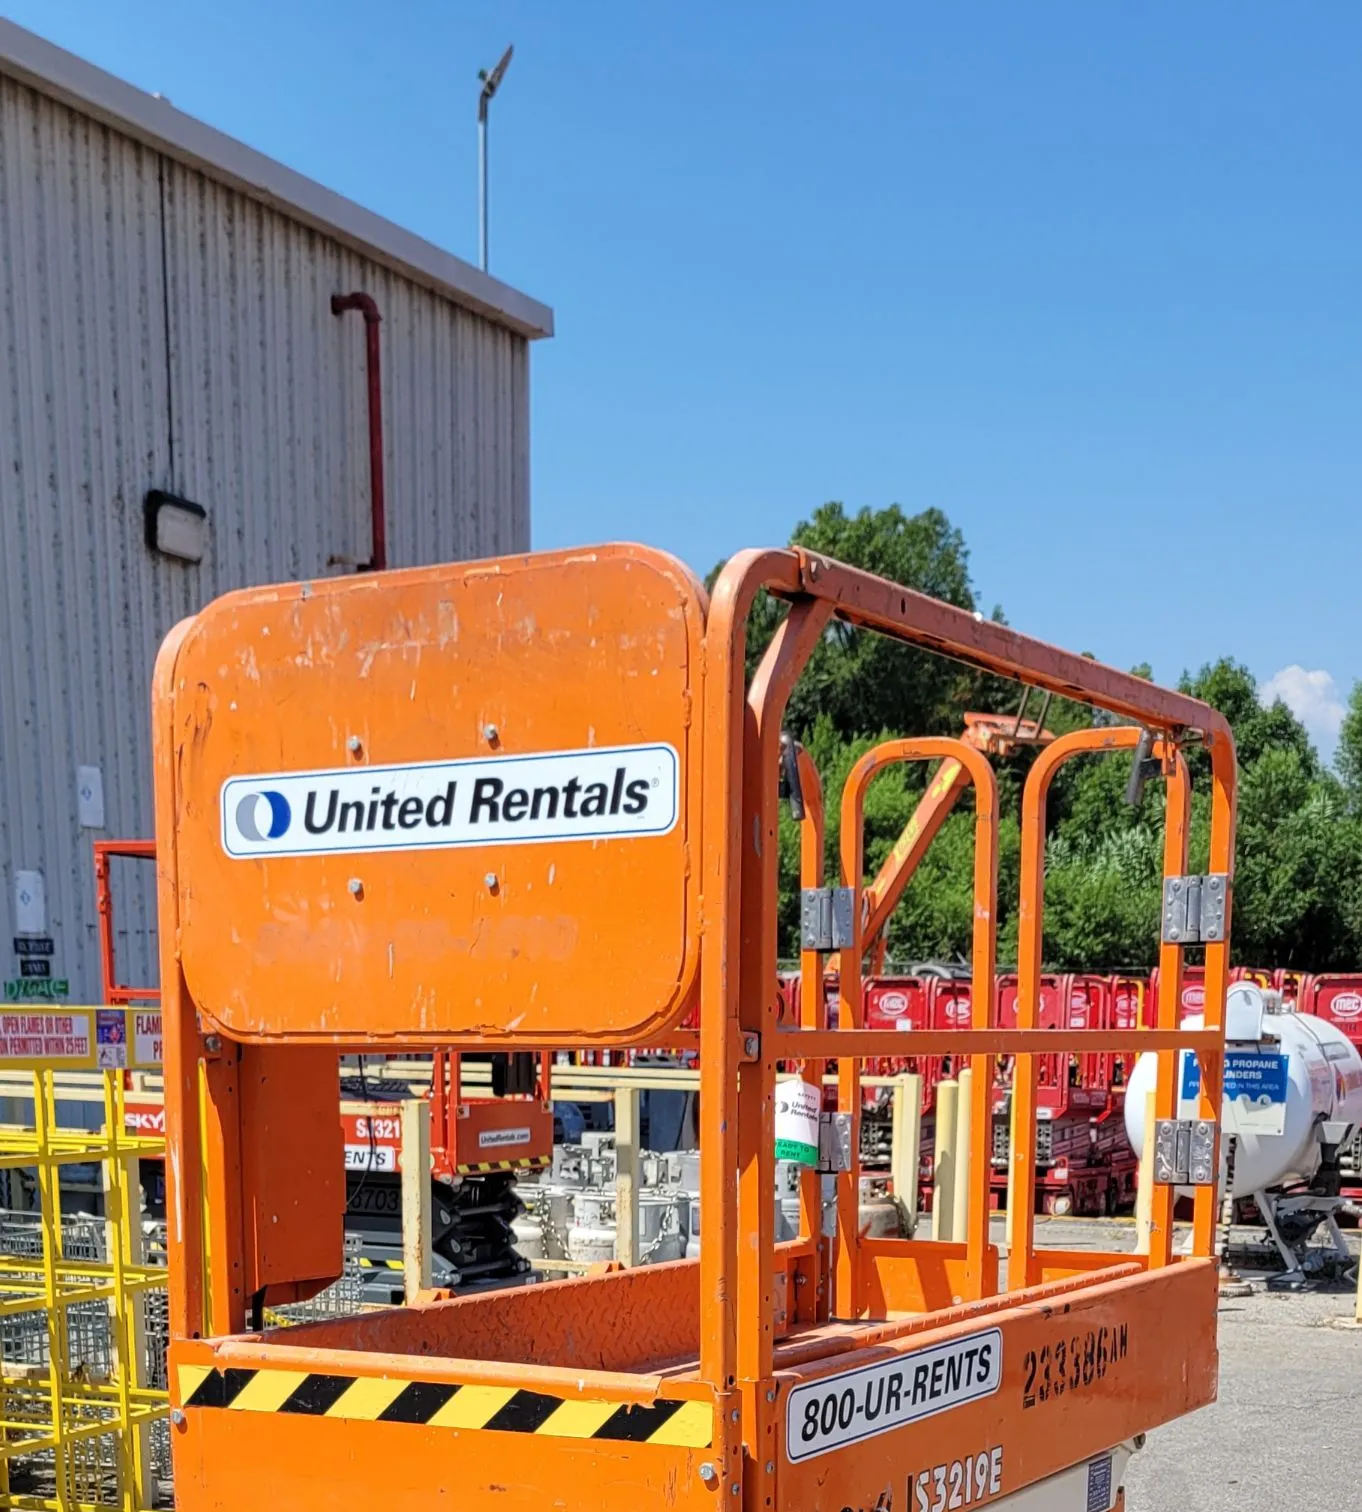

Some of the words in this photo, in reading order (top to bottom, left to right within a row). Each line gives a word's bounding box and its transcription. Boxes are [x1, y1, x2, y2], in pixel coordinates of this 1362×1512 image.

[303, 780, 458, 835] United
[469, 766, 650, 824] Rentals
[1232, 1059, 1279, 1070] PROPANE
[792, 1101, 818, 1114] United
[801, 1343, 992, 1442] 800-UR-RENTS
